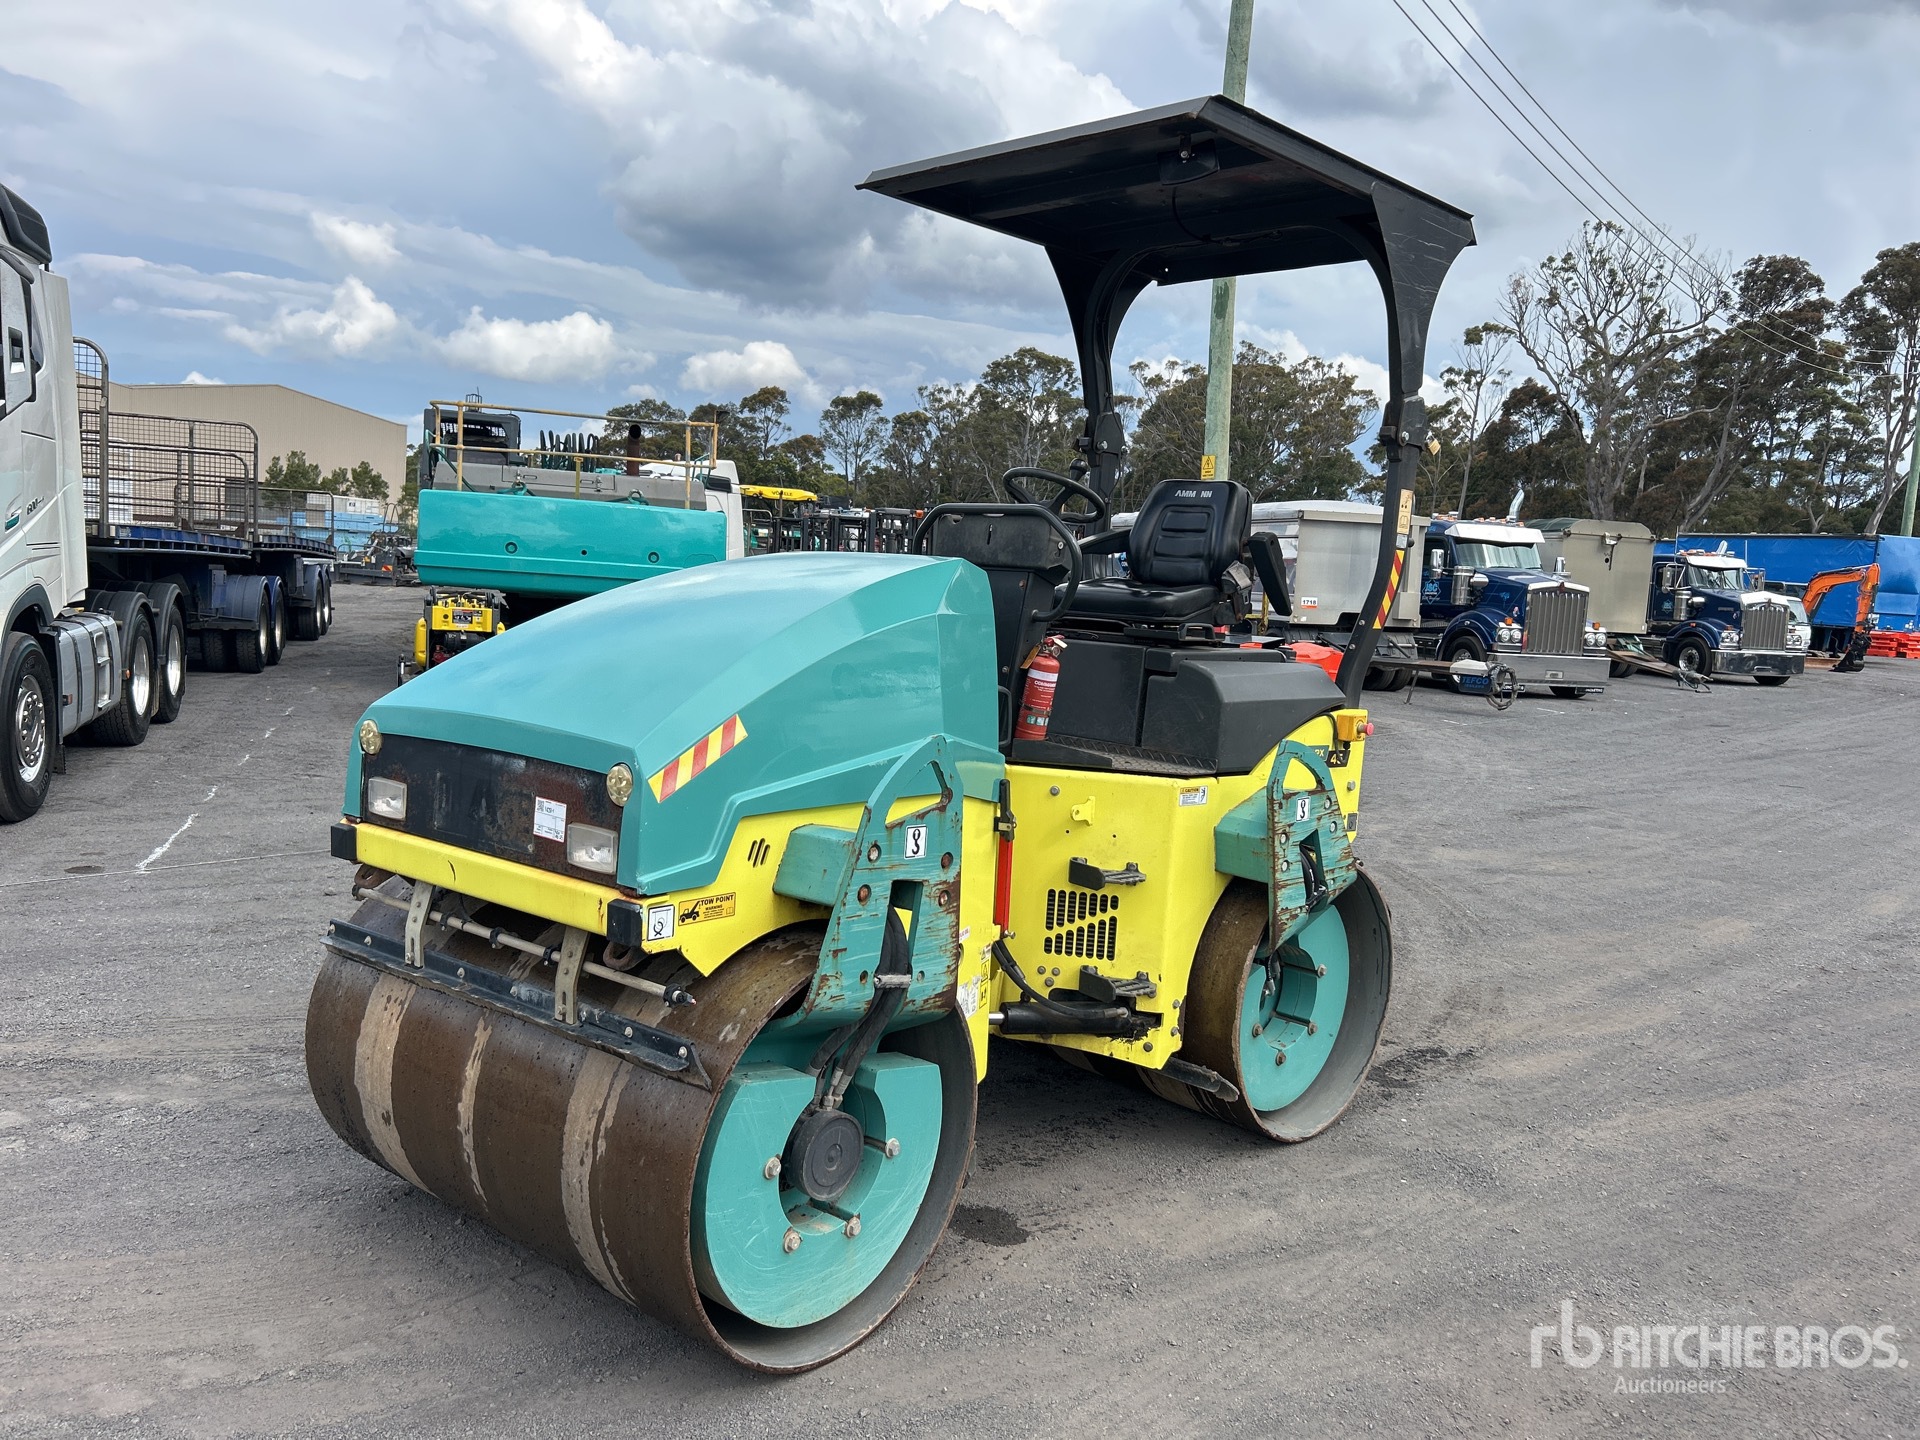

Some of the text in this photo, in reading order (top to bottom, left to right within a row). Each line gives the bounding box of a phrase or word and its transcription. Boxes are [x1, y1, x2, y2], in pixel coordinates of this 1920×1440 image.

[1461, 676, 1489, 685] TEFCO
[700, 894, 734, 906] TOW POINT
